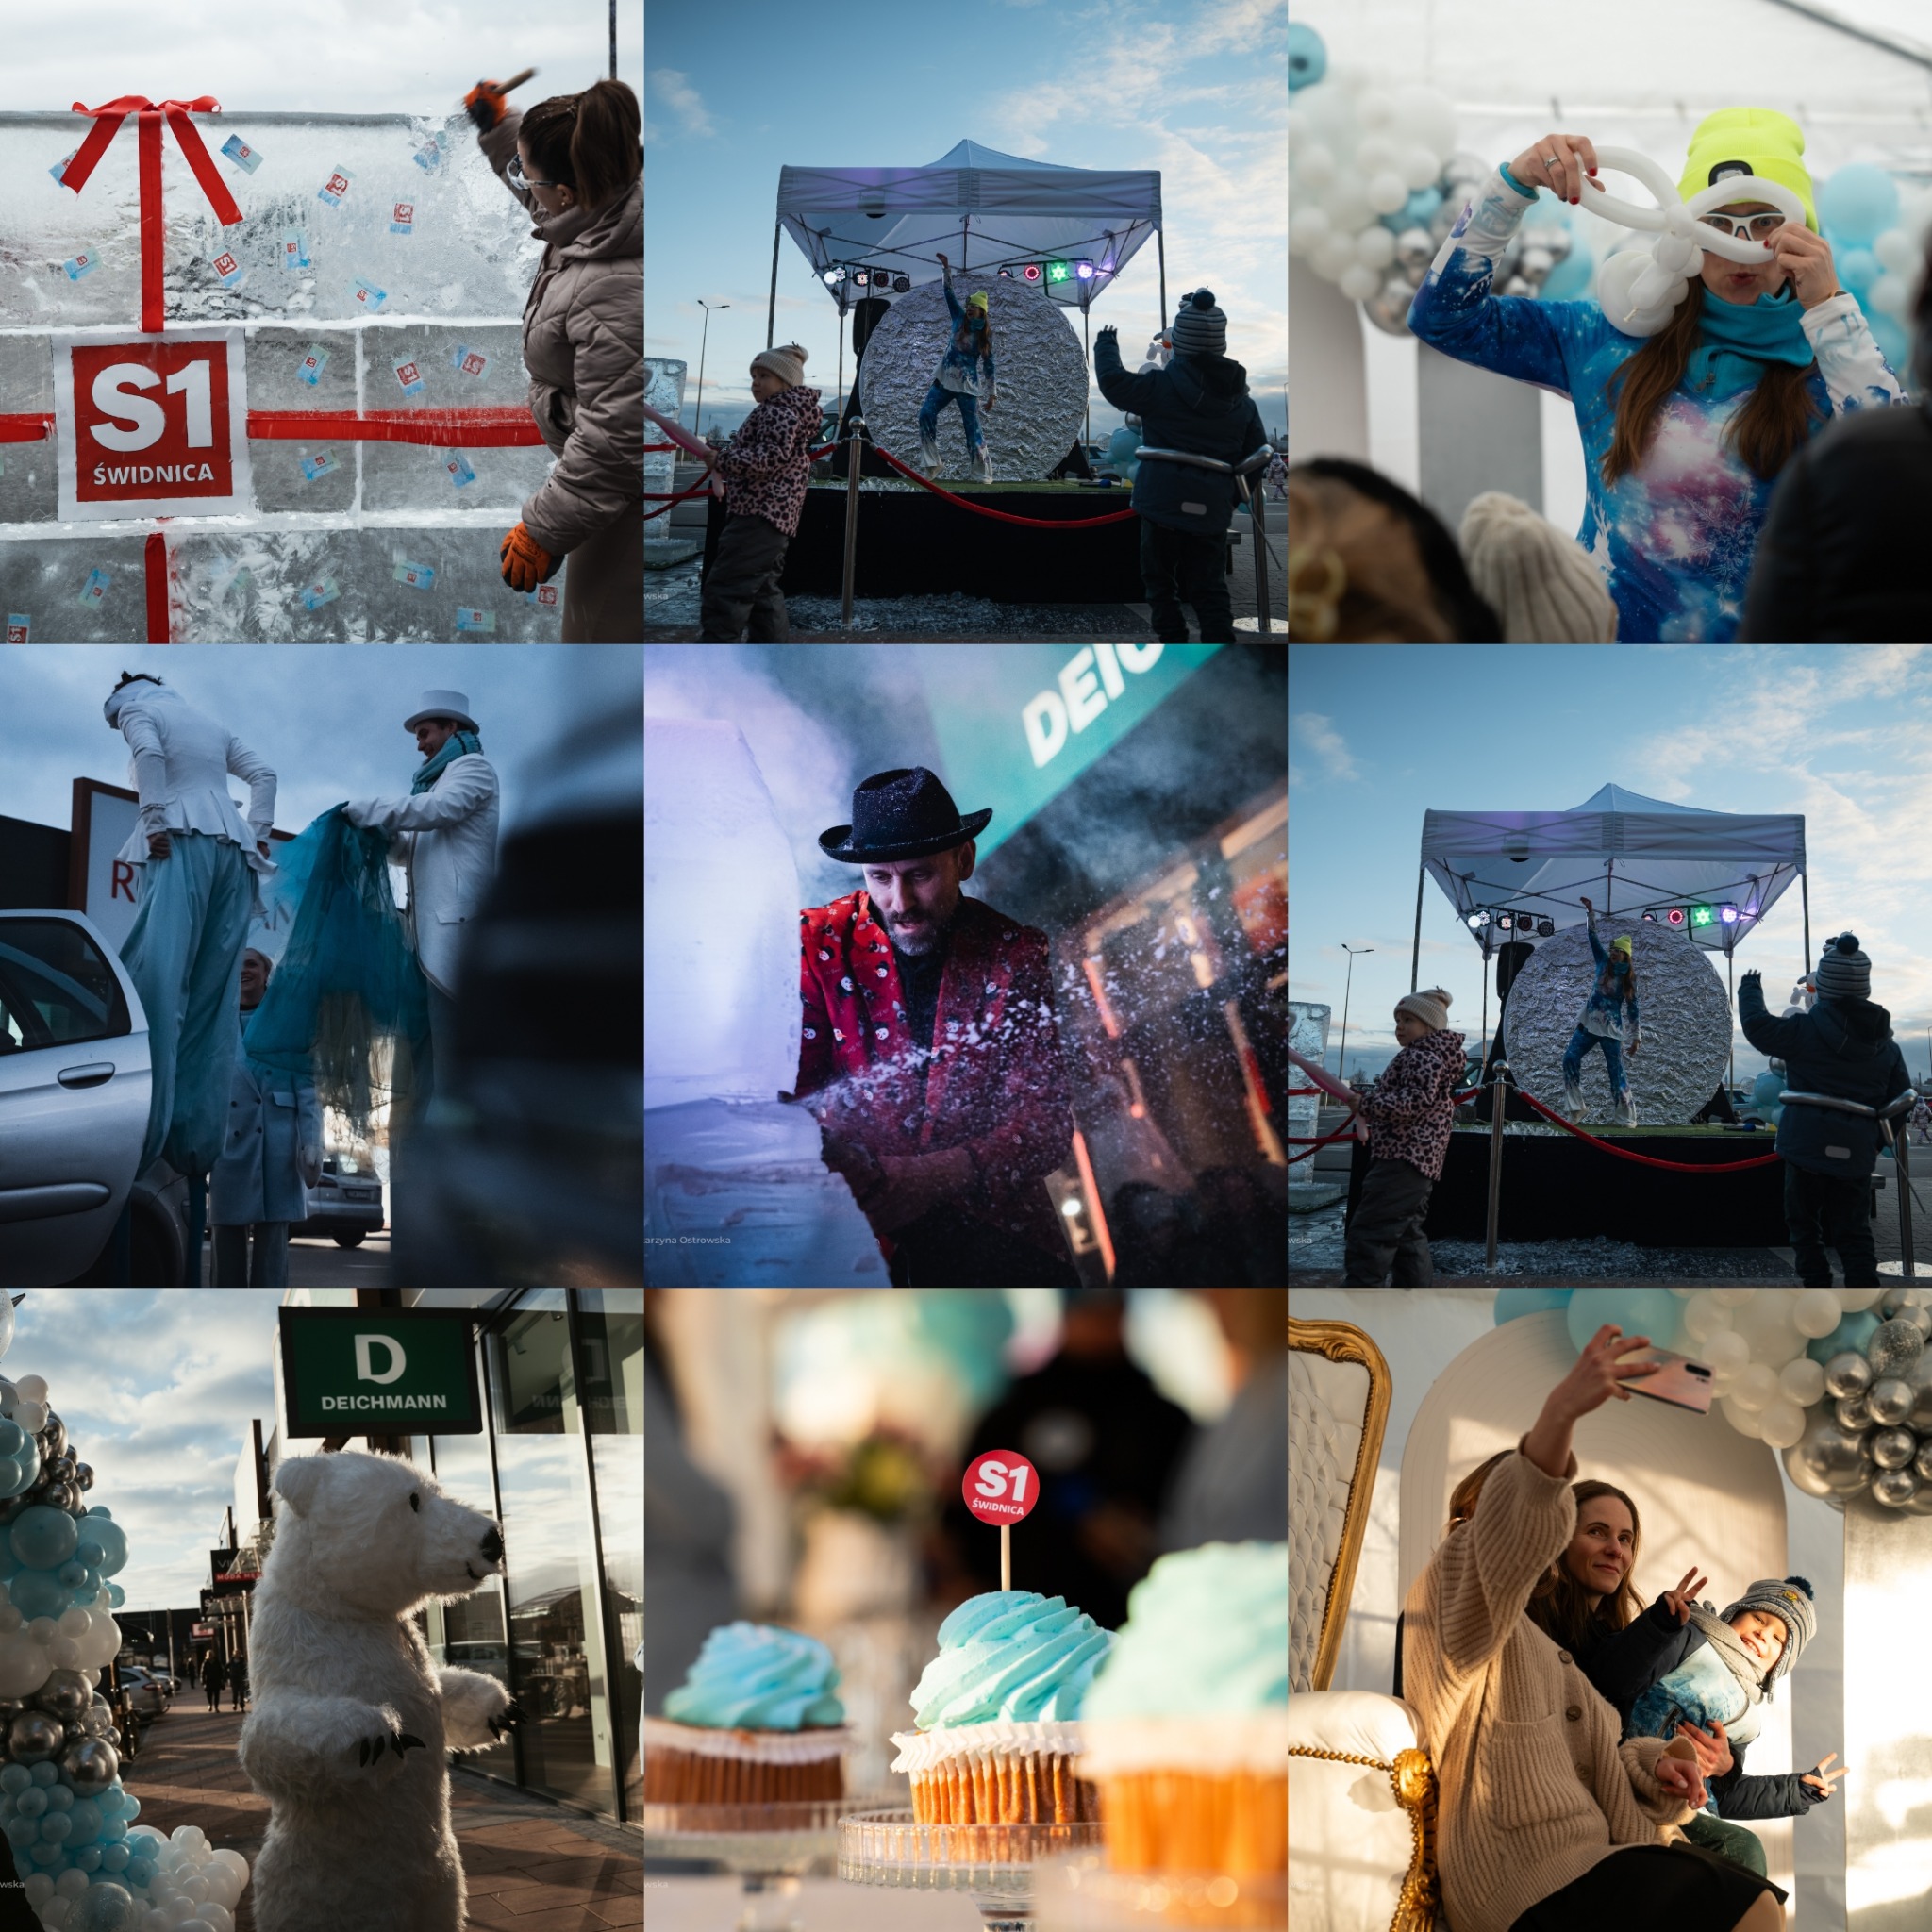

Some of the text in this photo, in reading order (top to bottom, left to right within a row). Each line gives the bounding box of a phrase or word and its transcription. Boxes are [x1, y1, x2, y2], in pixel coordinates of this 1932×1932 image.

[89, 359, 213, 453] S1
[93, 462, 215, 485] ŚWIDNICA
[354, 1333, 407, 1385] D
[321, 1394, 447, 1410] DEICHMANN
[974, 1460, 1029, 1502] S1
[972, 1497, 1024, 1516] ŚWIDNICA
